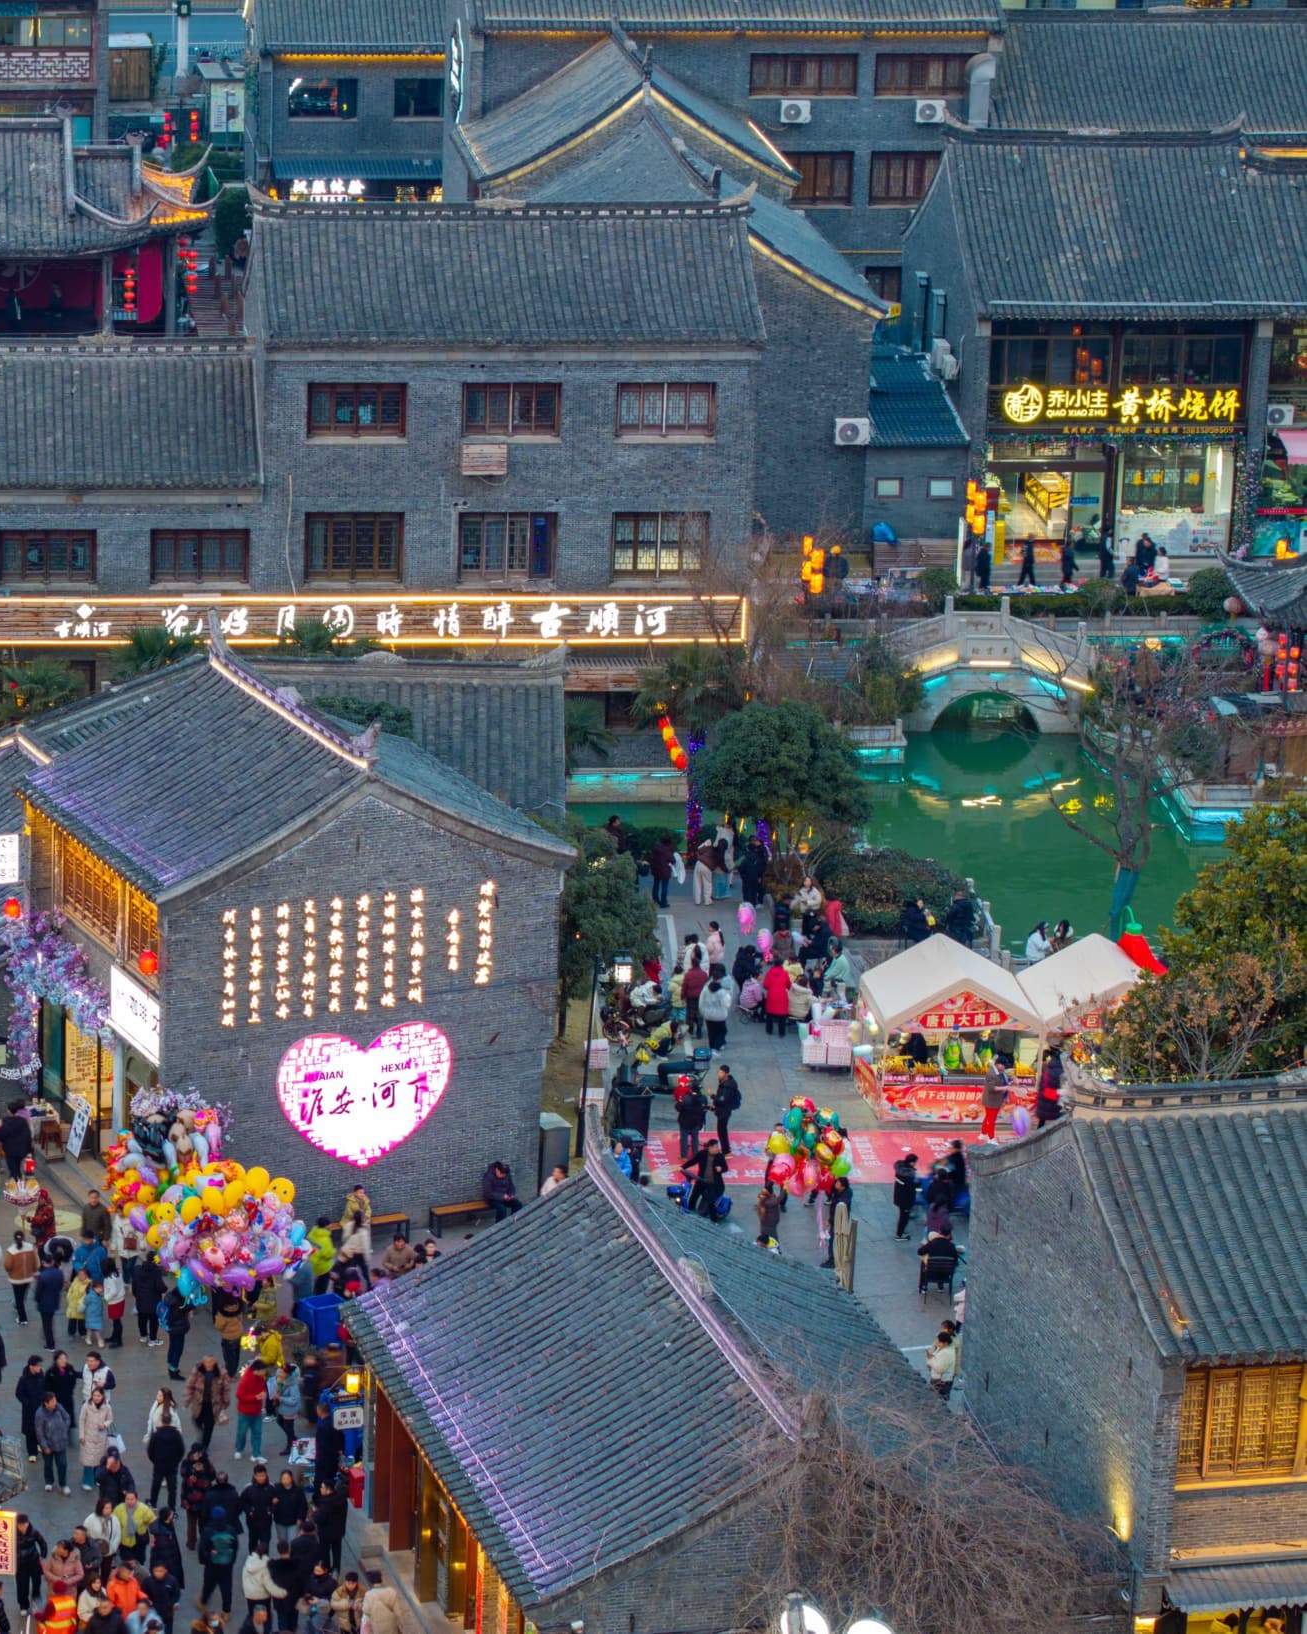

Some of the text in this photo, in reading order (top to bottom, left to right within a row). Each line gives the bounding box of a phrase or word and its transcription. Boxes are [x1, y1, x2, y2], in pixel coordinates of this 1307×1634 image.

[293, 178, 366, 195] 汉服体验
[1046, 408, 1108, 418] QIAO XIAO ZHU
[1113, 386, 1240, 424] 黄桥烧饼
[926, 1012, 1001, 1028] 唐僧大肉串
